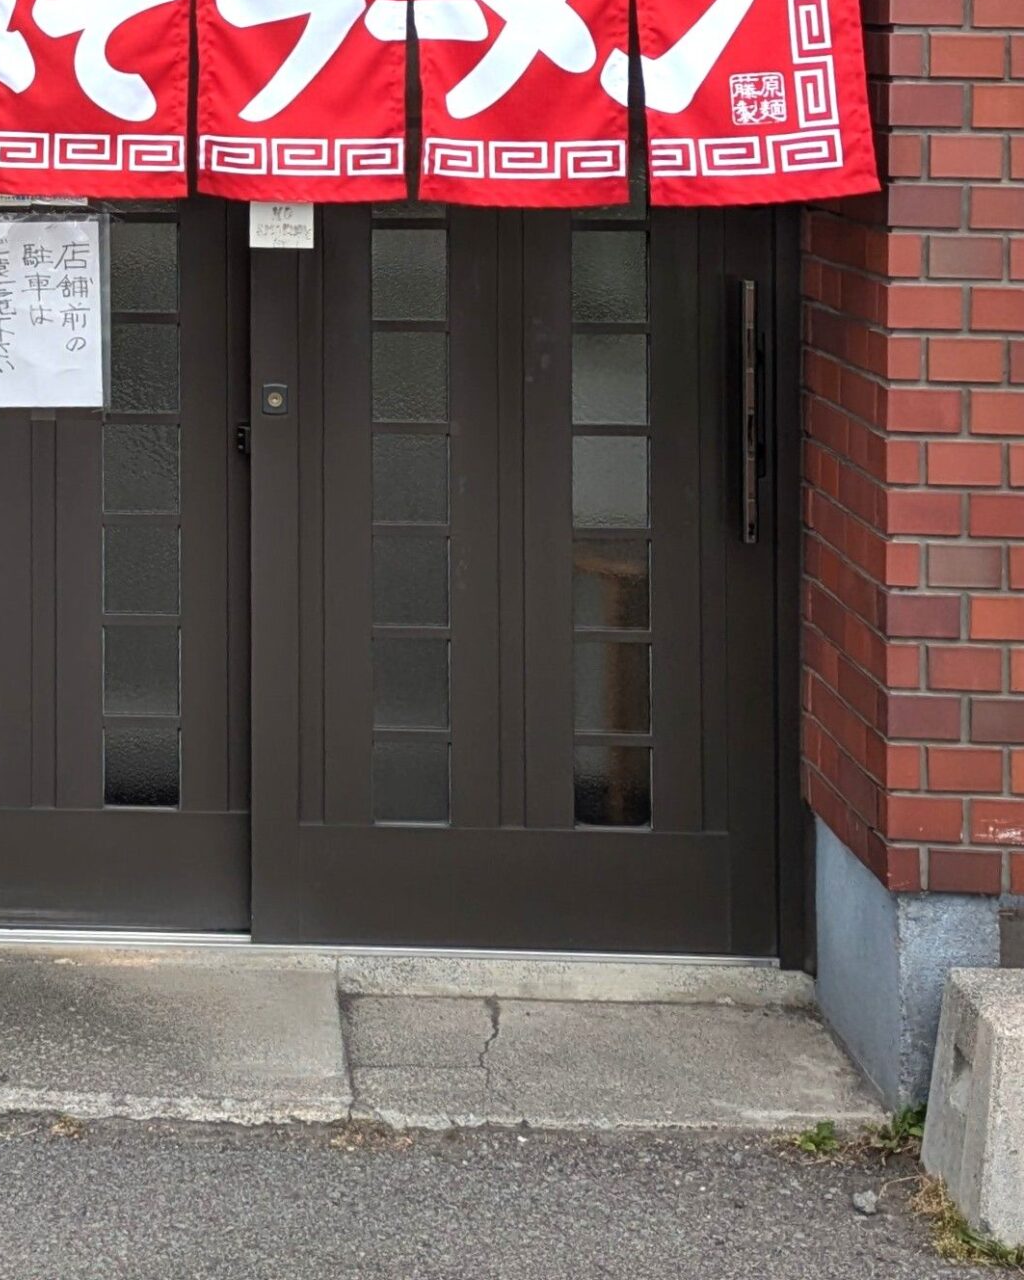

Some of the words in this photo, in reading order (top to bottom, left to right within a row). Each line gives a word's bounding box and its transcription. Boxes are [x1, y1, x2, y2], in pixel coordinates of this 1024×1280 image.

[21, 243, 56, 326] 駐車は
[54, 241, 94, 352] 店舗前の
